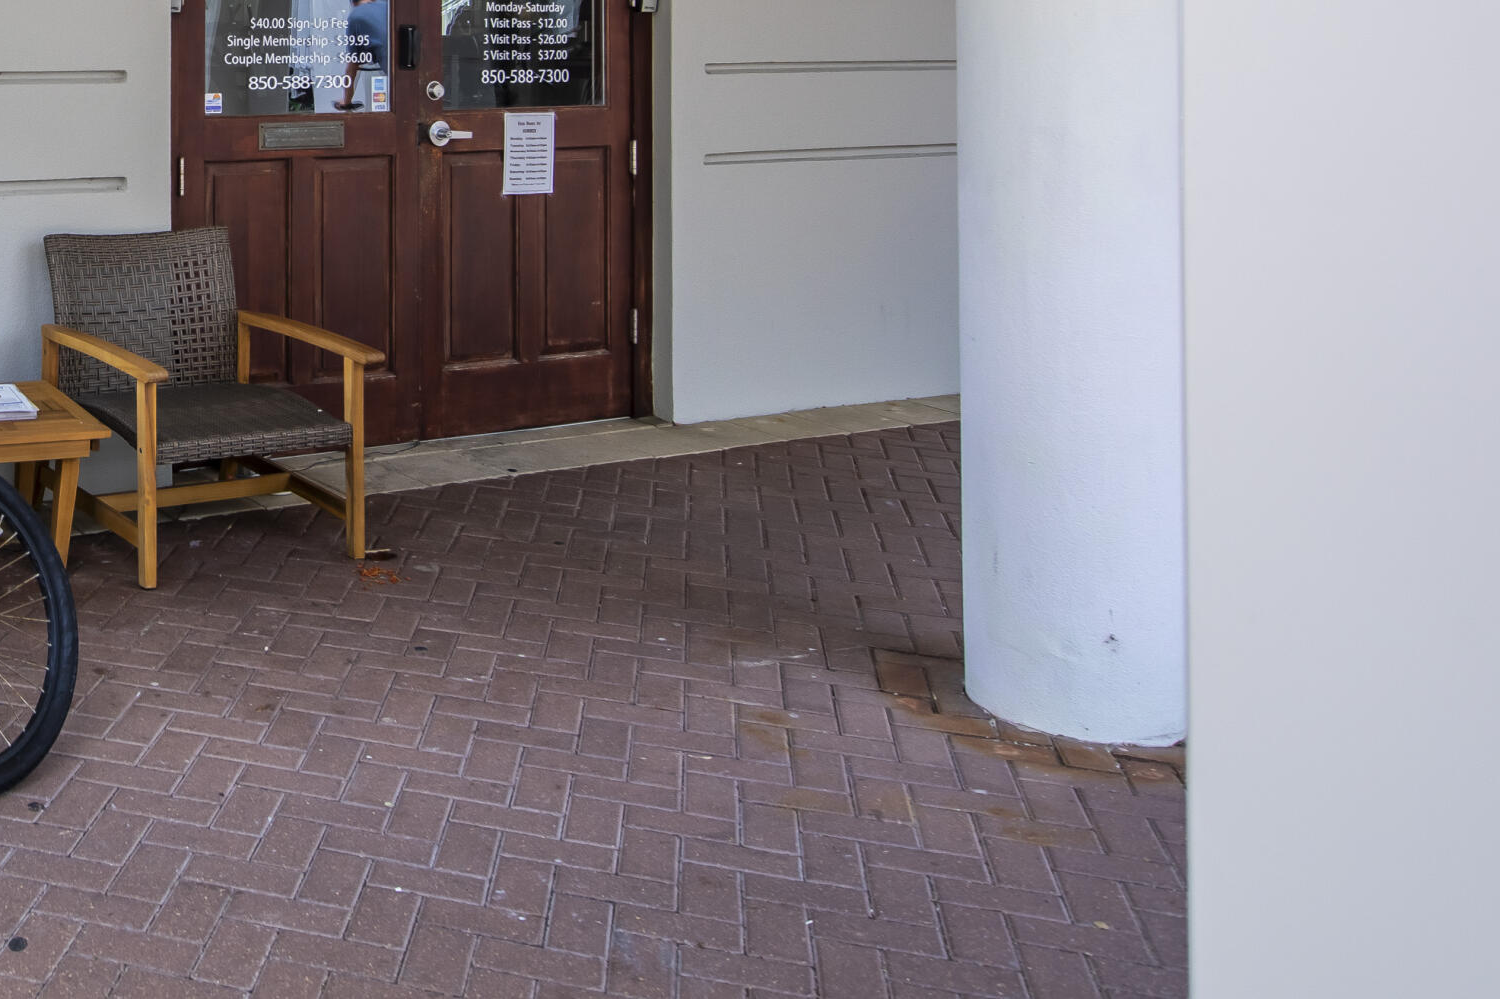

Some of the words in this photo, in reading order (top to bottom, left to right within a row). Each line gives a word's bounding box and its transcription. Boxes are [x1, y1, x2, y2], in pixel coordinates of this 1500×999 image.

[485, 1, 565, 15] Monday-Saturday
[250, 17, 285, 29] $40.00
[331, 17, 349, 29] Fee
[484, 18, 489, 29] 1
[490, 18, 510, 29] Visit
[511, 18, 531, 29] Pass
[538, 18, 568, 29] $12.00
[227, 35, 260, 49] Single
[262, 35, 328, 49] Membership
[337, 34, 370, 46] $39.95
[483, 34, 489, 45] 3
[490, 34, 510, 45] Visit
[511, 34, 531, 45] Pass
[538, 34, 568, 45] $26.00
[224, 52, 263, 67] Couple
[265, 52, 331, 66] Membership
[339, 52, 372, 64] $66.00
[483, 50, 489, 60] 5
[490, 50, 510, 60] Visit
[511, 50, 531, 60] Pass
[538, 49, 568, 60] $37.00
[248, 75, 352, 90] 850-588-7300
[481, 68, 570, 83] 850-588-7300
